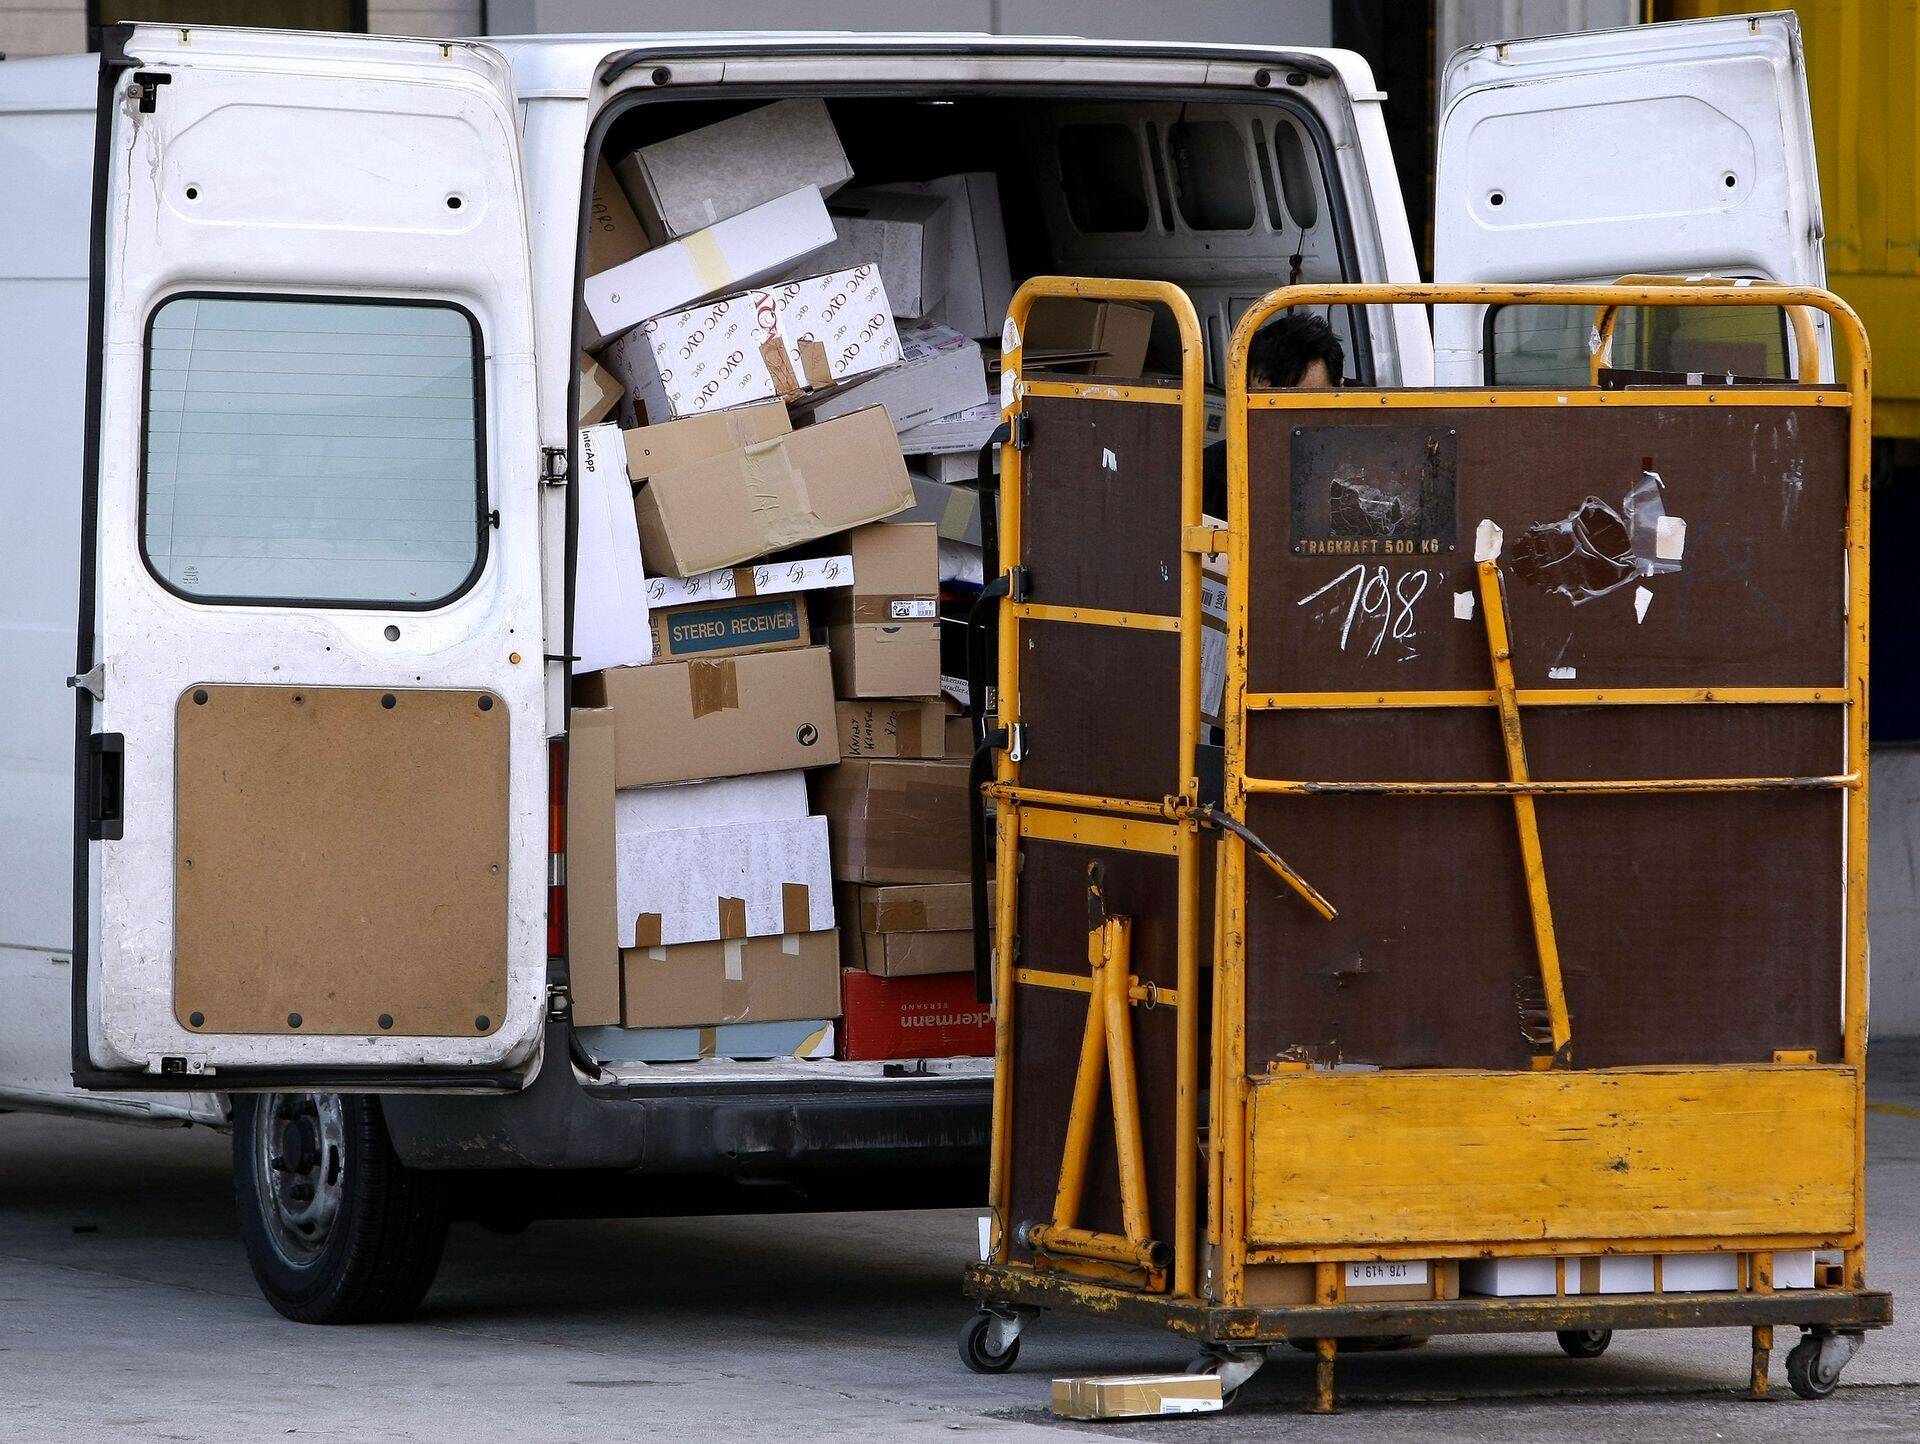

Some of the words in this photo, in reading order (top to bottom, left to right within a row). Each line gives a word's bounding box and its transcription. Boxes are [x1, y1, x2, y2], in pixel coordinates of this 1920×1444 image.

[820, 275, 834, 291] QVC
[846, 265, 871, 293] QVC
[775, 283, 800, 311] QVC
[866, 286, 879, 302] QVC
[704, 301, 729, 330] QVC
[795, 304, 809, 321] QVC
[821, 293, 847, 322] QVC
[677, 312, 691, 328] QVC
[860, 313, 885, 343] QVC
[725, 323, 738, 339] QVC
[833, 325, 847, 341] QVC
[680, 330, 705, 360] QVC
[879, 336, 893, 352] QVC
[719, 350, 744, 380] QVC
[835, 343, 860, 373] QVC
[692, 362, 706, 378] QVC
[739, 373, 752, 389] QVC
[694, 380, 719, 410] QVC
[582, 430, 595, 472] InterApp
[1299, 539, 1378, 554] TRAGKRAFT
[1385, 540, 1414, 554] 500
[1422, 539, 1440, 554] KG
[673, 620, 725, 642] STEREO
[732, 612, 794, 635] RECEIVER
[901, 1002, 948, 1011] VERSAND
[900, 1012, 997, 1028] ckermann
